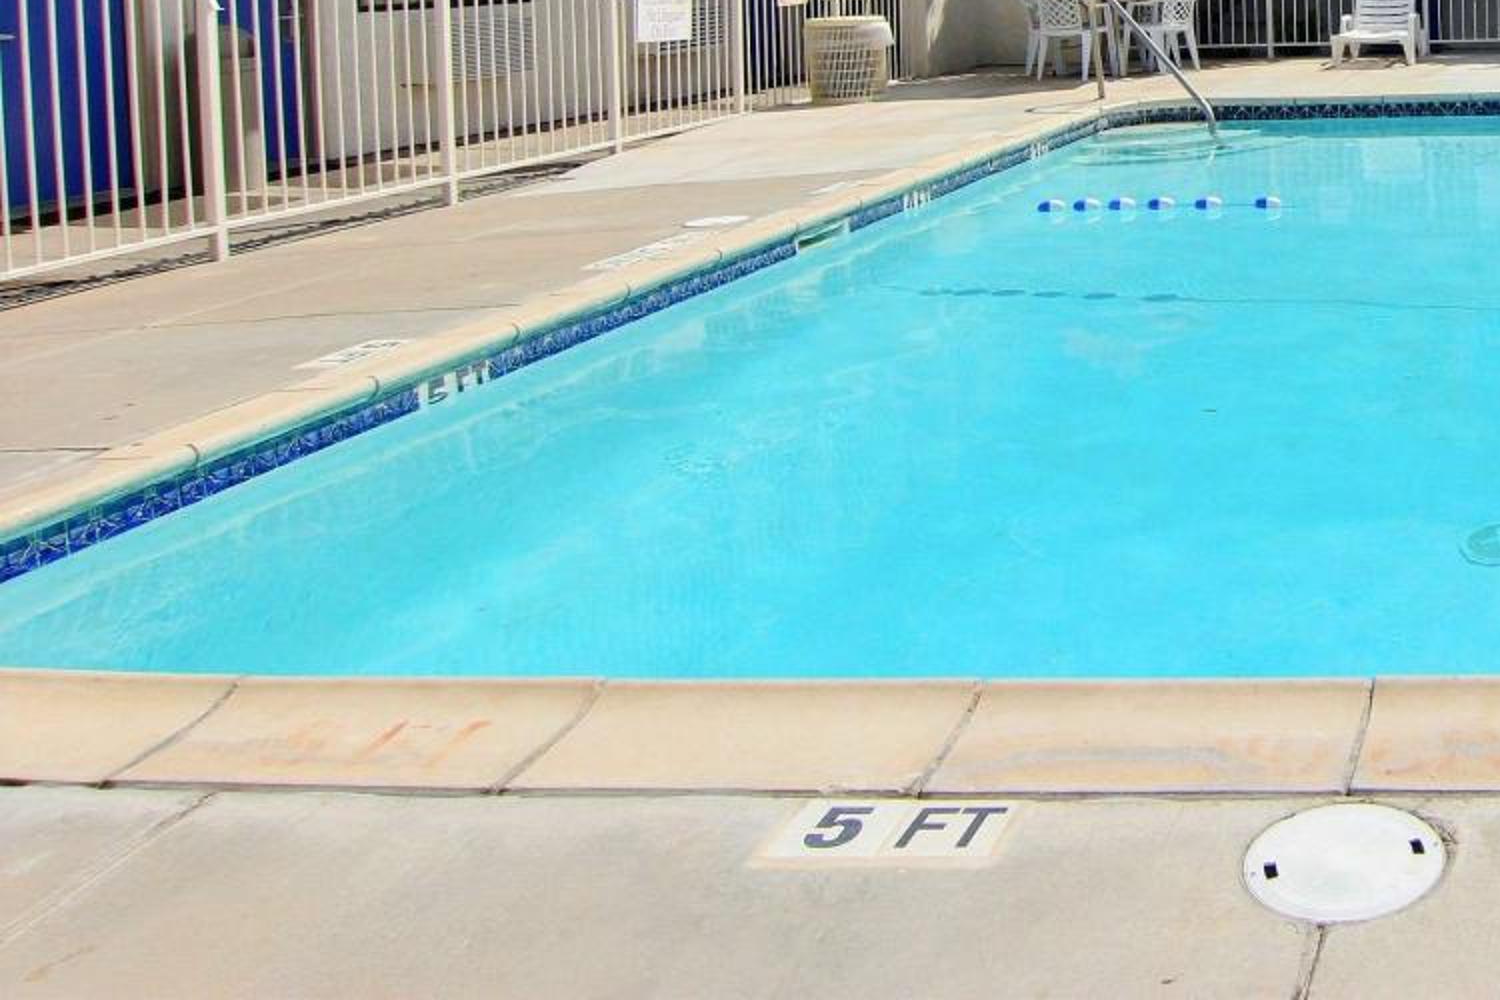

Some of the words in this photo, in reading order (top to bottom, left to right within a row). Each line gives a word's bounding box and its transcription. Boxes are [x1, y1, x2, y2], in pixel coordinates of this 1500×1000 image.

[428, 375, 449, 405] 5
[455, 361, 487, 393] FT
[803, 807, 874, 849] 5
[895, 807, 1008, 849] FT
